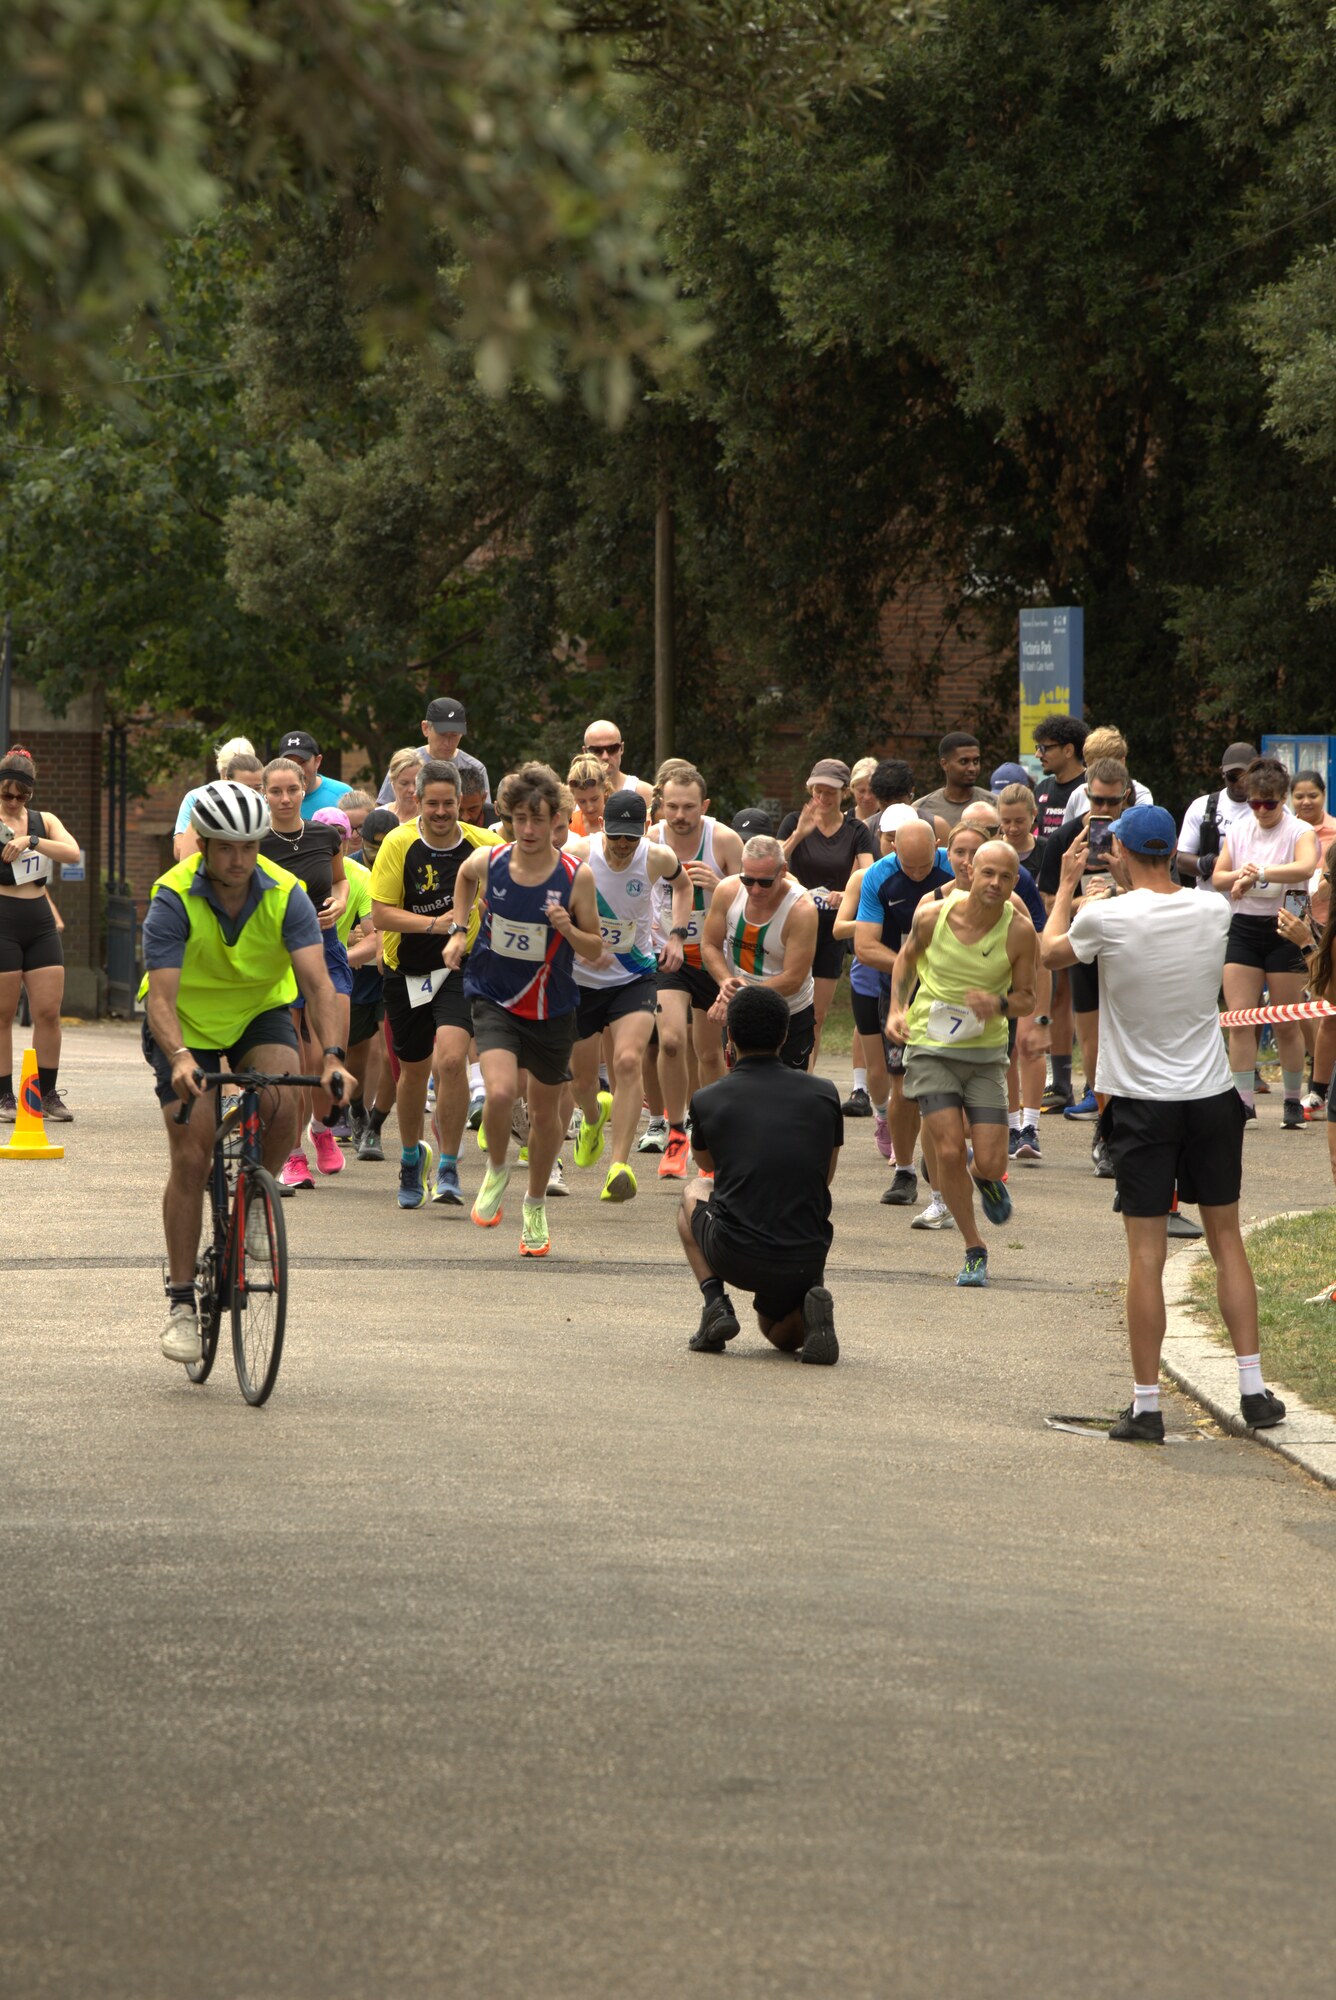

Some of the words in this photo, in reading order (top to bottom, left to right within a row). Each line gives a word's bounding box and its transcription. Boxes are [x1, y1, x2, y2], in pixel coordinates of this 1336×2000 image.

[1022, 640, 1040, 656] Victoria
[1041, 640, 1052, 655] Park
[22, 856, 39, 874] 77
[412, 895, 454, 914] Run&F
[504, 931, 529, 951] 78
[950, 1016, 963, 1035] 7
